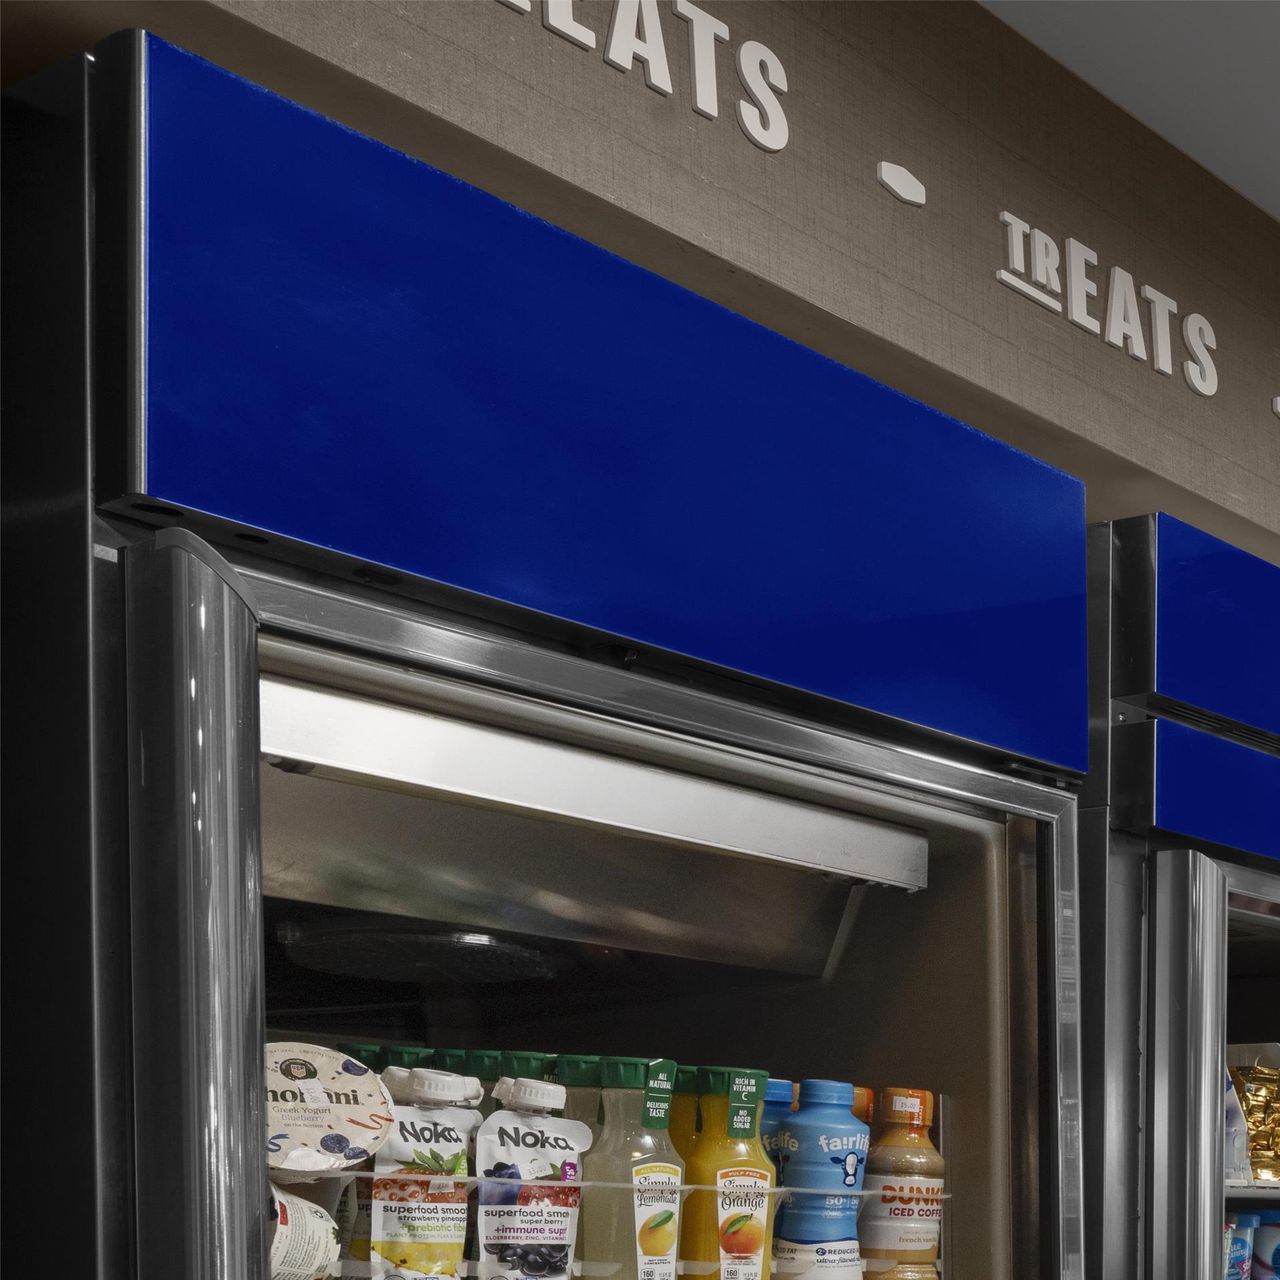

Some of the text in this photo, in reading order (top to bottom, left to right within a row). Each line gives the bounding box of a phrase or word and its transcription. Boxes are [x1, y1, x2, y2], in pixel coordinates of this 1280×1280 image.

[997, 210, 1219, 397] TREATS
[741, 1092, 748, 1101] C
[649, 1109, 665, 1118] TASTE
[733, 1115, 751, 1123] ADDED
[400, 1121, 462, 1144] Noka
[498, 1127, 575, 1151] Noka
[383, 1205, 438, 1214] superfood
[484, 1209, 543, 1217] superfood
[889, 1208, 915, 1216] ICED
